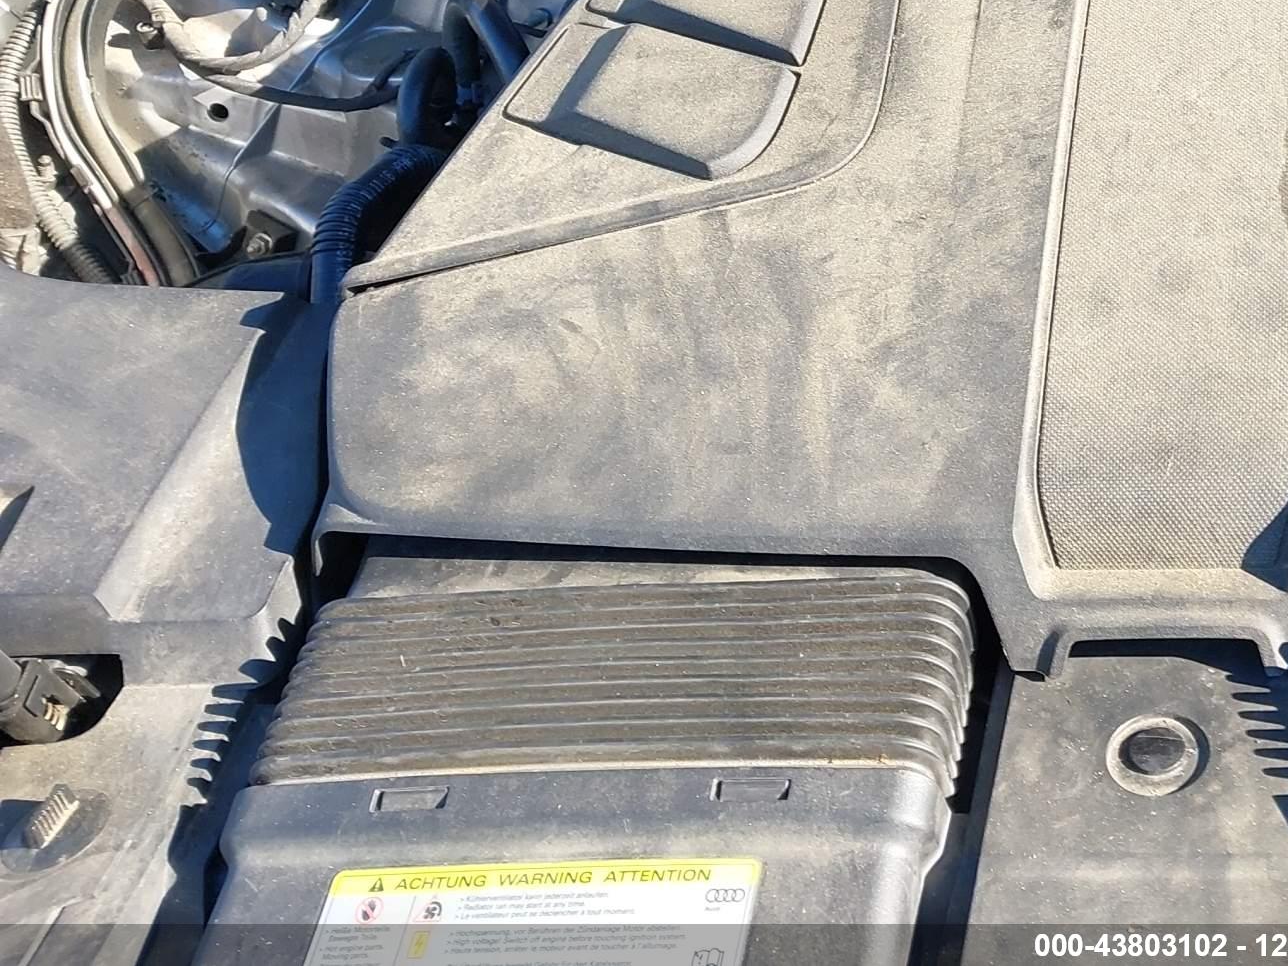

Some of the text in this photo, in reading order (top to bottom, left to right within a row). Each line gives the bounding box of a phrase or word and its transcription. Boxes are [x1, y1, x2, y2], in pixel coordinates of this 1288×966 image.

[394, 868, 712, 890] ACHTUNG WARNING ATTENTION
